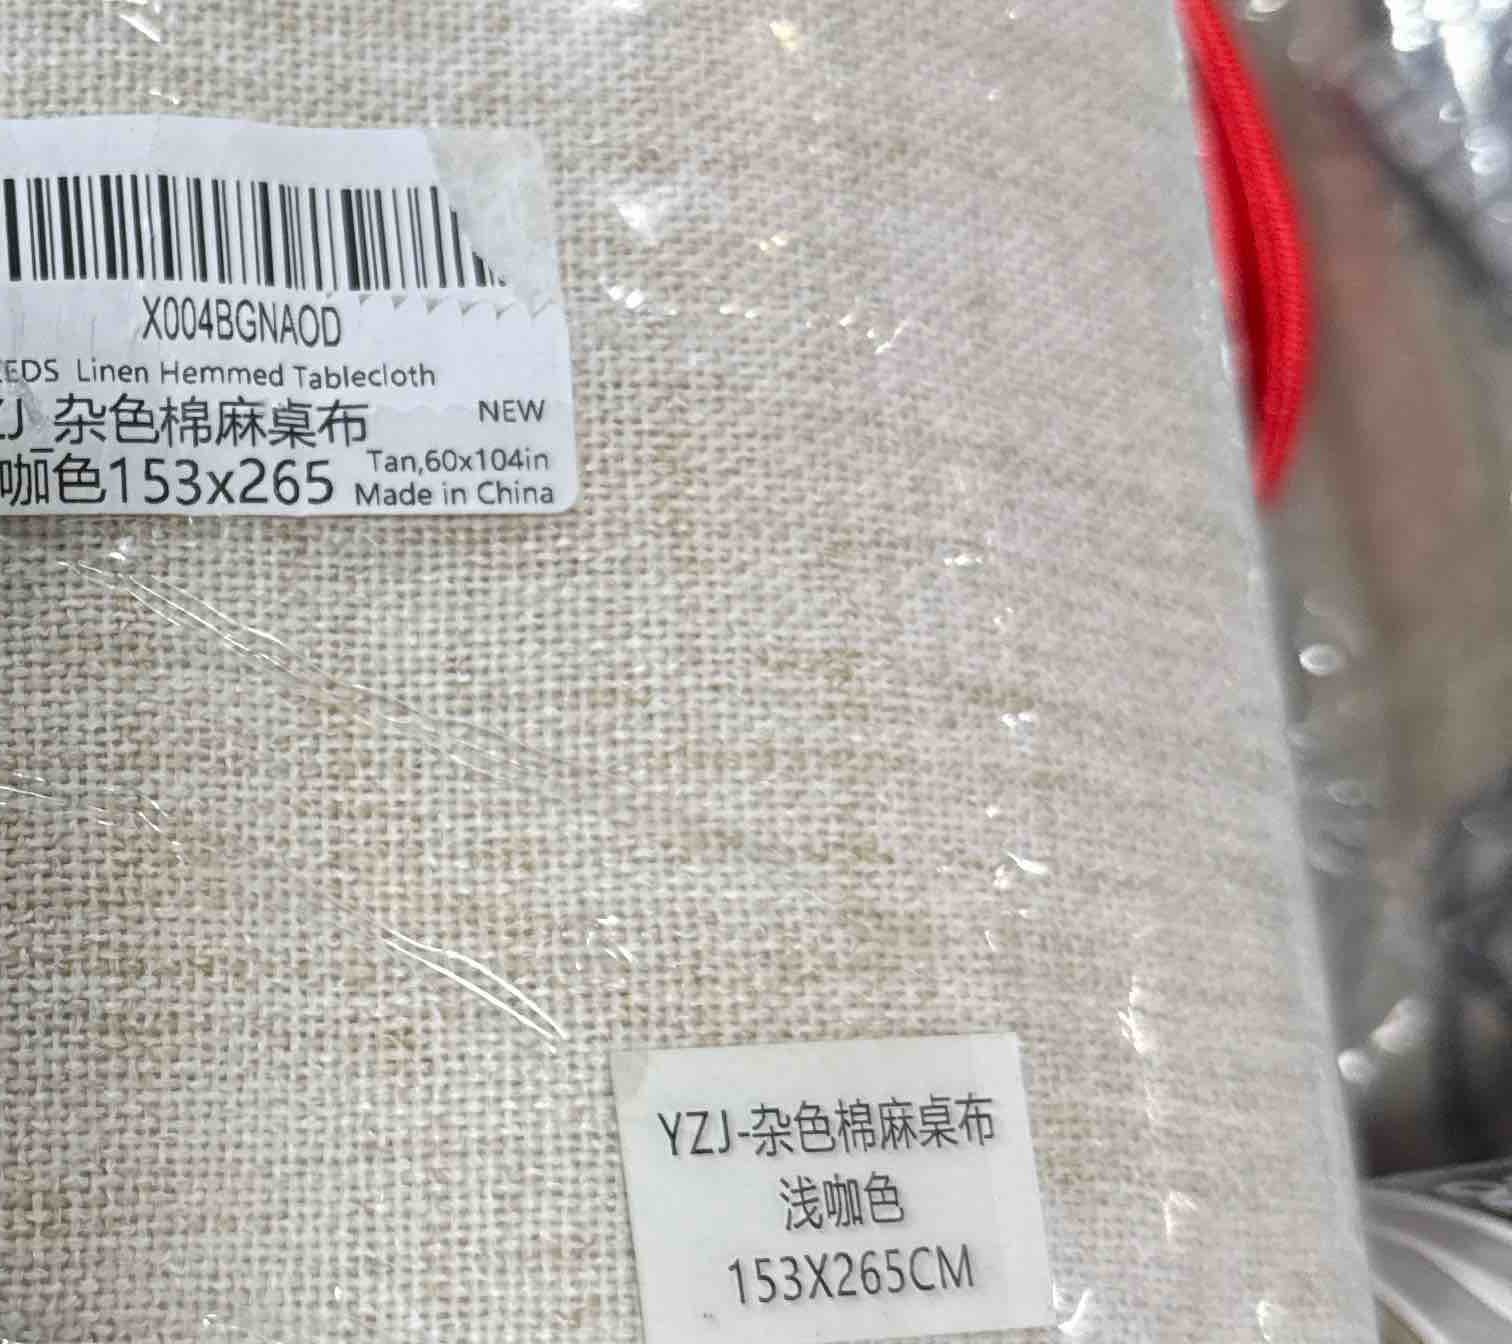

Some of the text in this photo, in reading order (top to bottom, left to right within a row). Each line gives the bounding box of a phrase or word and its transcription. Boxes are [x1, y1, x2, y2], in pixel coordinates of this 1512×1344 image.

[77, 358, 148, 383] Linen
[160, 361, 284, 386] Hemmed
[293, 363, 436, 389] Tablecloth
[478, 400, 545, 423] NEW
[366, 448, 549, 475] Tan,60x104in
[355, 481, 554, 506] Made in China
[657, 1093, 994, 1157] YZJ-杂色棉麻桌布
[778, 1171, 906, 1231] 浅咖色
[728, 1244, 975, 1305] 153X265CM
